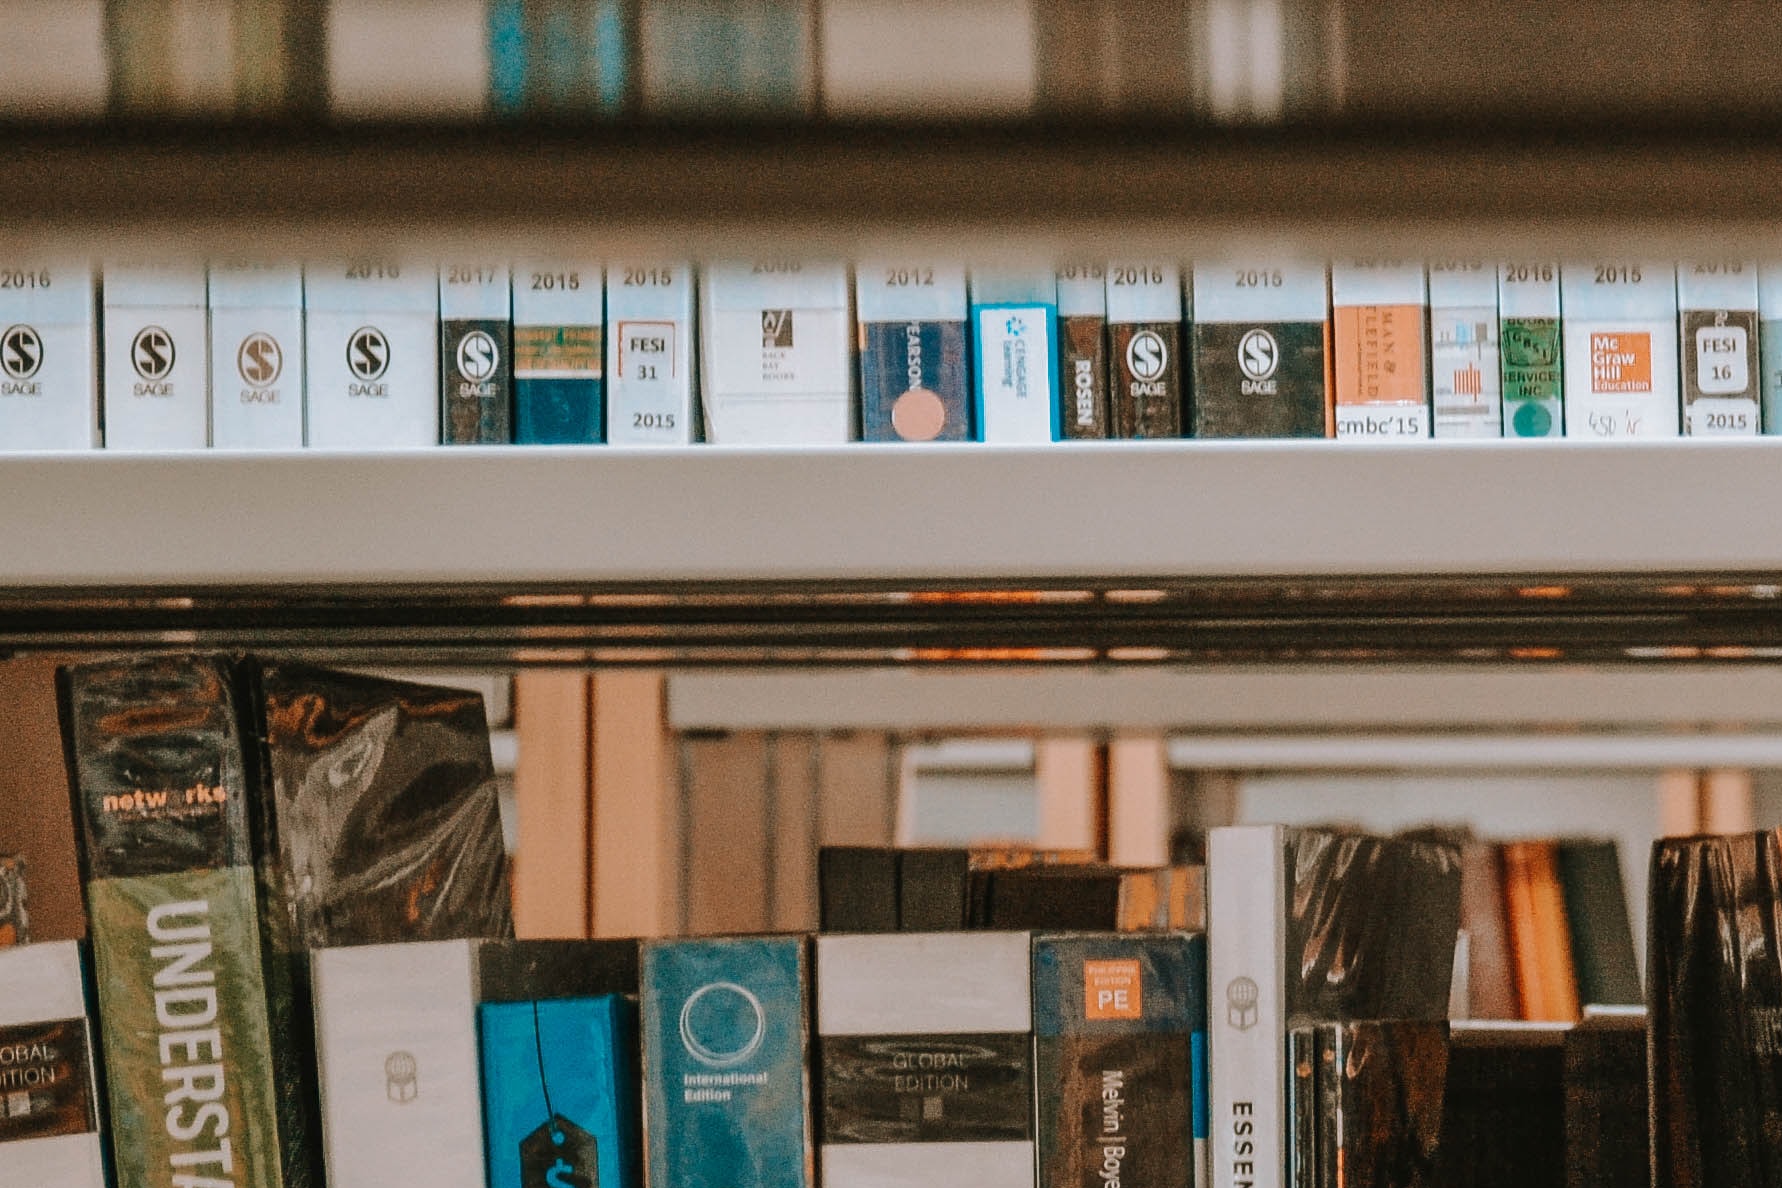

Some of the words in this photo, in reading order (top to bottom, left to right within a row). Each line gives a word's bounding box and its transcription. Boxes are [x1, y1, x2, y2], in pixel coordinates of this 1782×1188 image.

[531, 272, 580, 291] 2015
[623, 269, 672, 288] 2015
[885, 269, 935, 287] 2012
[1593, 336, 1619, 351] Mc
[1593, 351, 1636, 367] Graw
[637, 365, 658, 380] 31
[1594, 365, 1622, 380] Hill
[1711, 366, 1732, 381] 16
[1, 383, 43, 397] SAGE
[133, 383, 174, 397] SAGE
[349, 383, 389, 397] SAGE
[459, 382, 496, 397] SAGE
[1075, 360, 1093, 426] ROSEN
[1130, 383, 1167, 397] SAGE
[1241, 381, 1278, 396] SAGE
[1594, 380, 1650, 392] Education
[240, 389, 281, 403] SAGE
[633, 412, 675, 429] 2015
[1705, 413, 1747, 430] 2015
[1098, 988, 1129, 1011] PE
[683, 1070, 769, 1087] International
[683, 1088, 733, 1102] Edition
